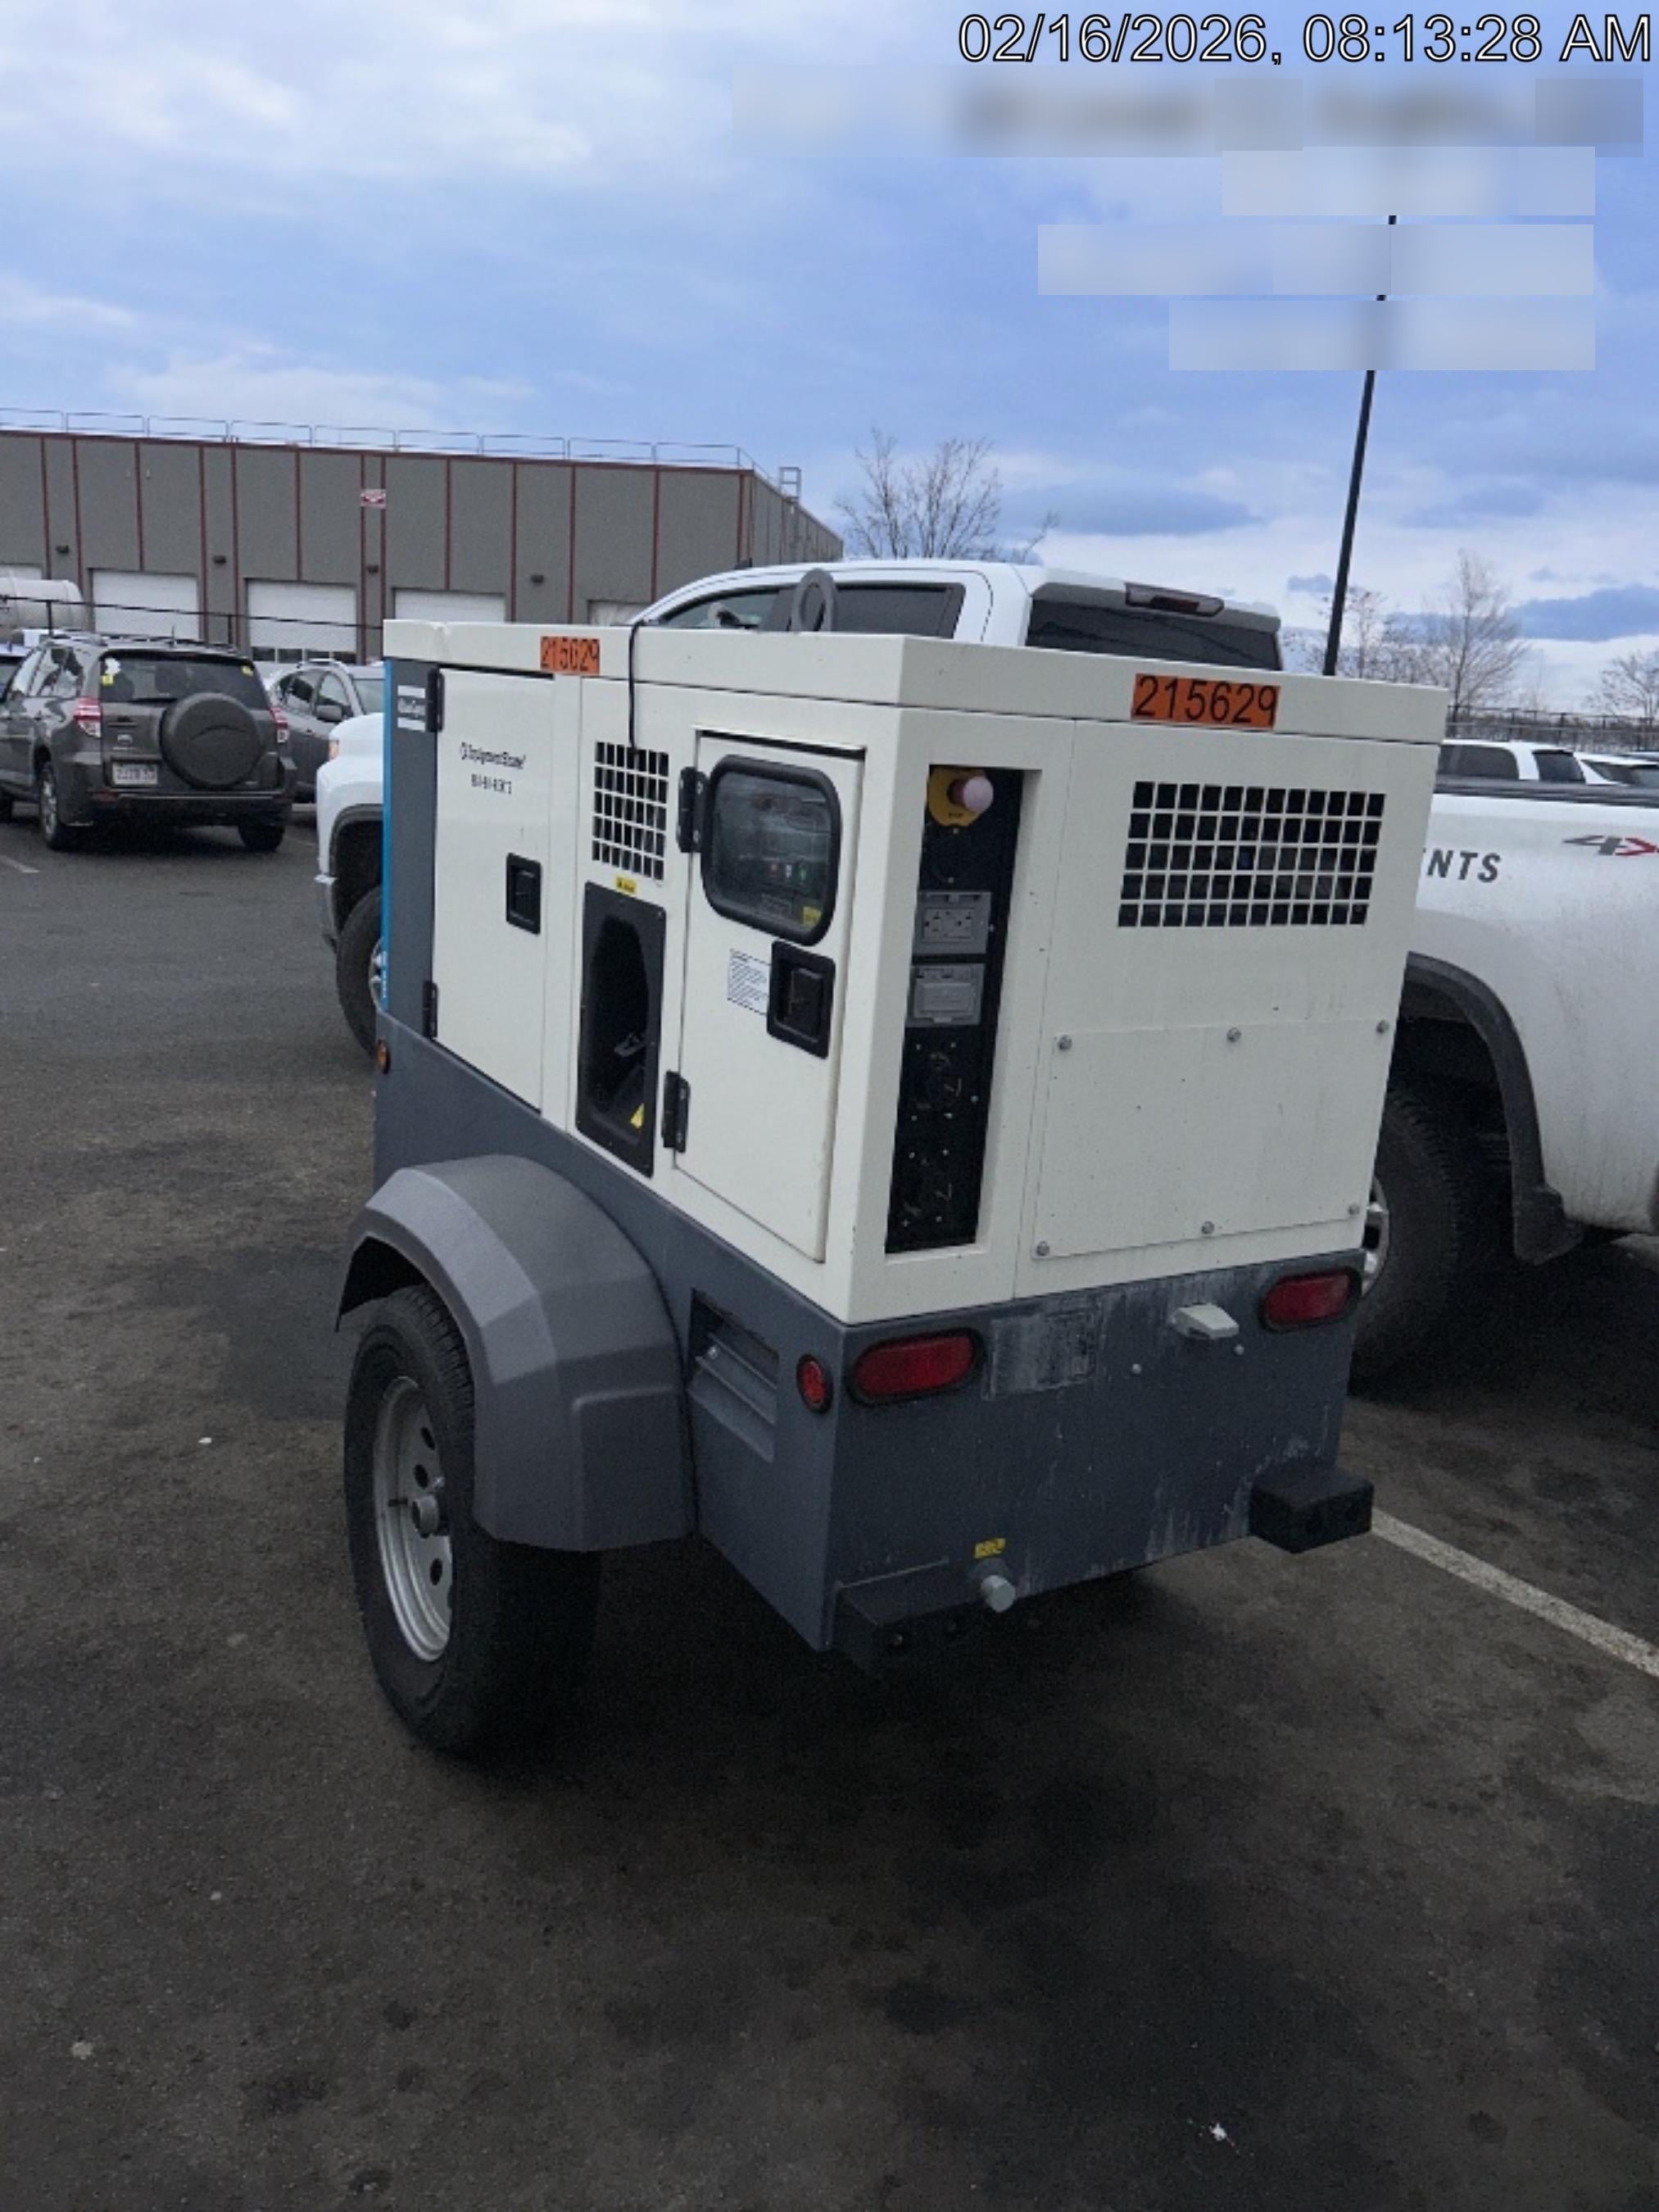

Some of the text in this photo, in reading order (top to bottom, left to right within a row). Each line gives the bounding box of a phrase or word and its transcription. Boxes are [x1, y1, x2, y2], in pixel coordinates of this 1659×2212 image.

[541, 636, 599, 672] 215629
[1134, 674, 1276, 726] 215629
[1423, 848, 1501, 882] NTS
